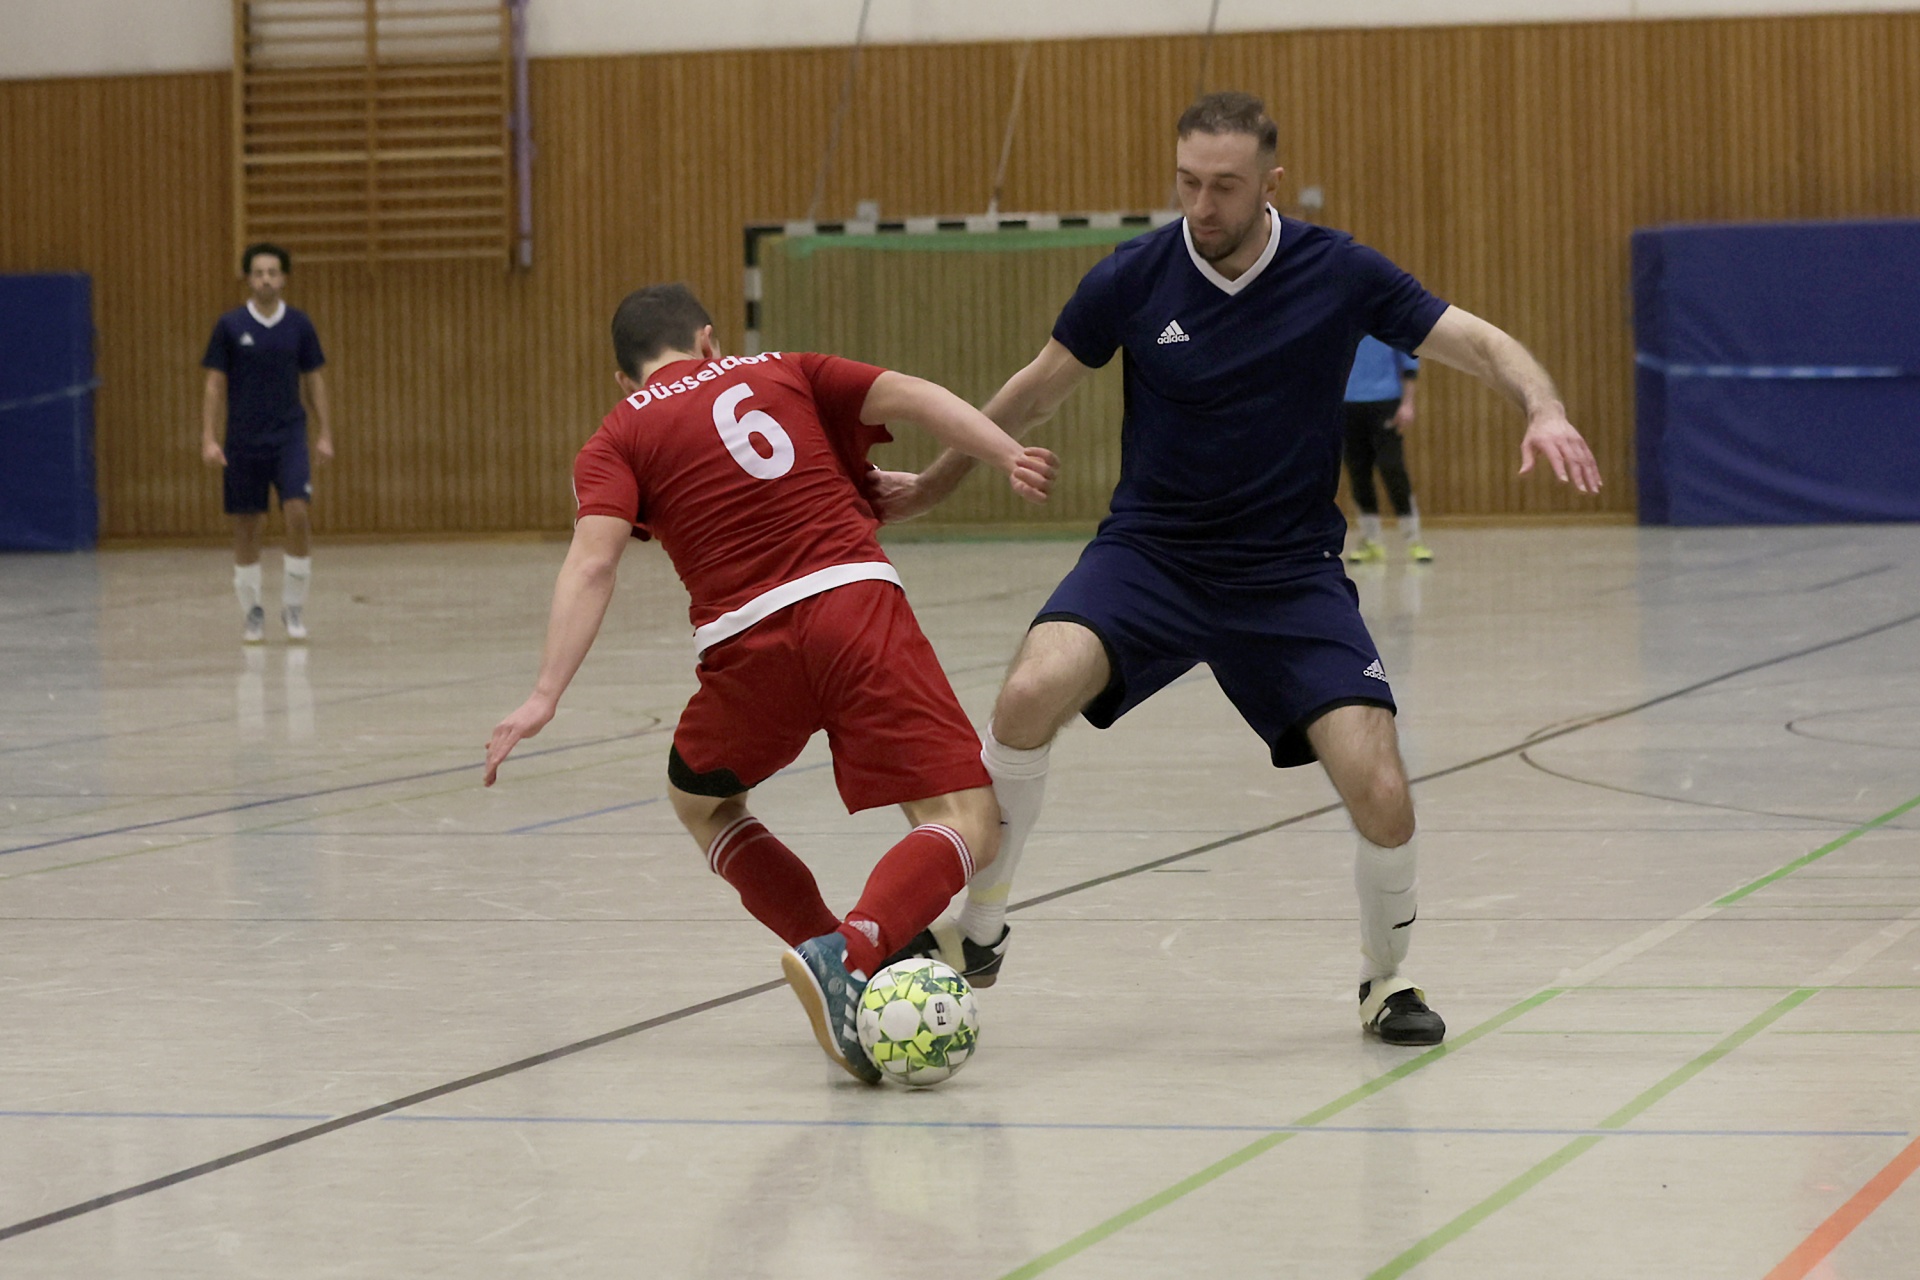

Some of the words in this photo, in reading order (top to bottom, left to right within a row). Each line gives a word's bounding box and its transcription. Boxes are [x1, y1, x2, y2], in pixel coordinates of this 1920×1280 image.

[1157, 334, 1190, 345] adidas
[712, 382, 795, 480] 6
[935, 1001, 946, 1026] FS
